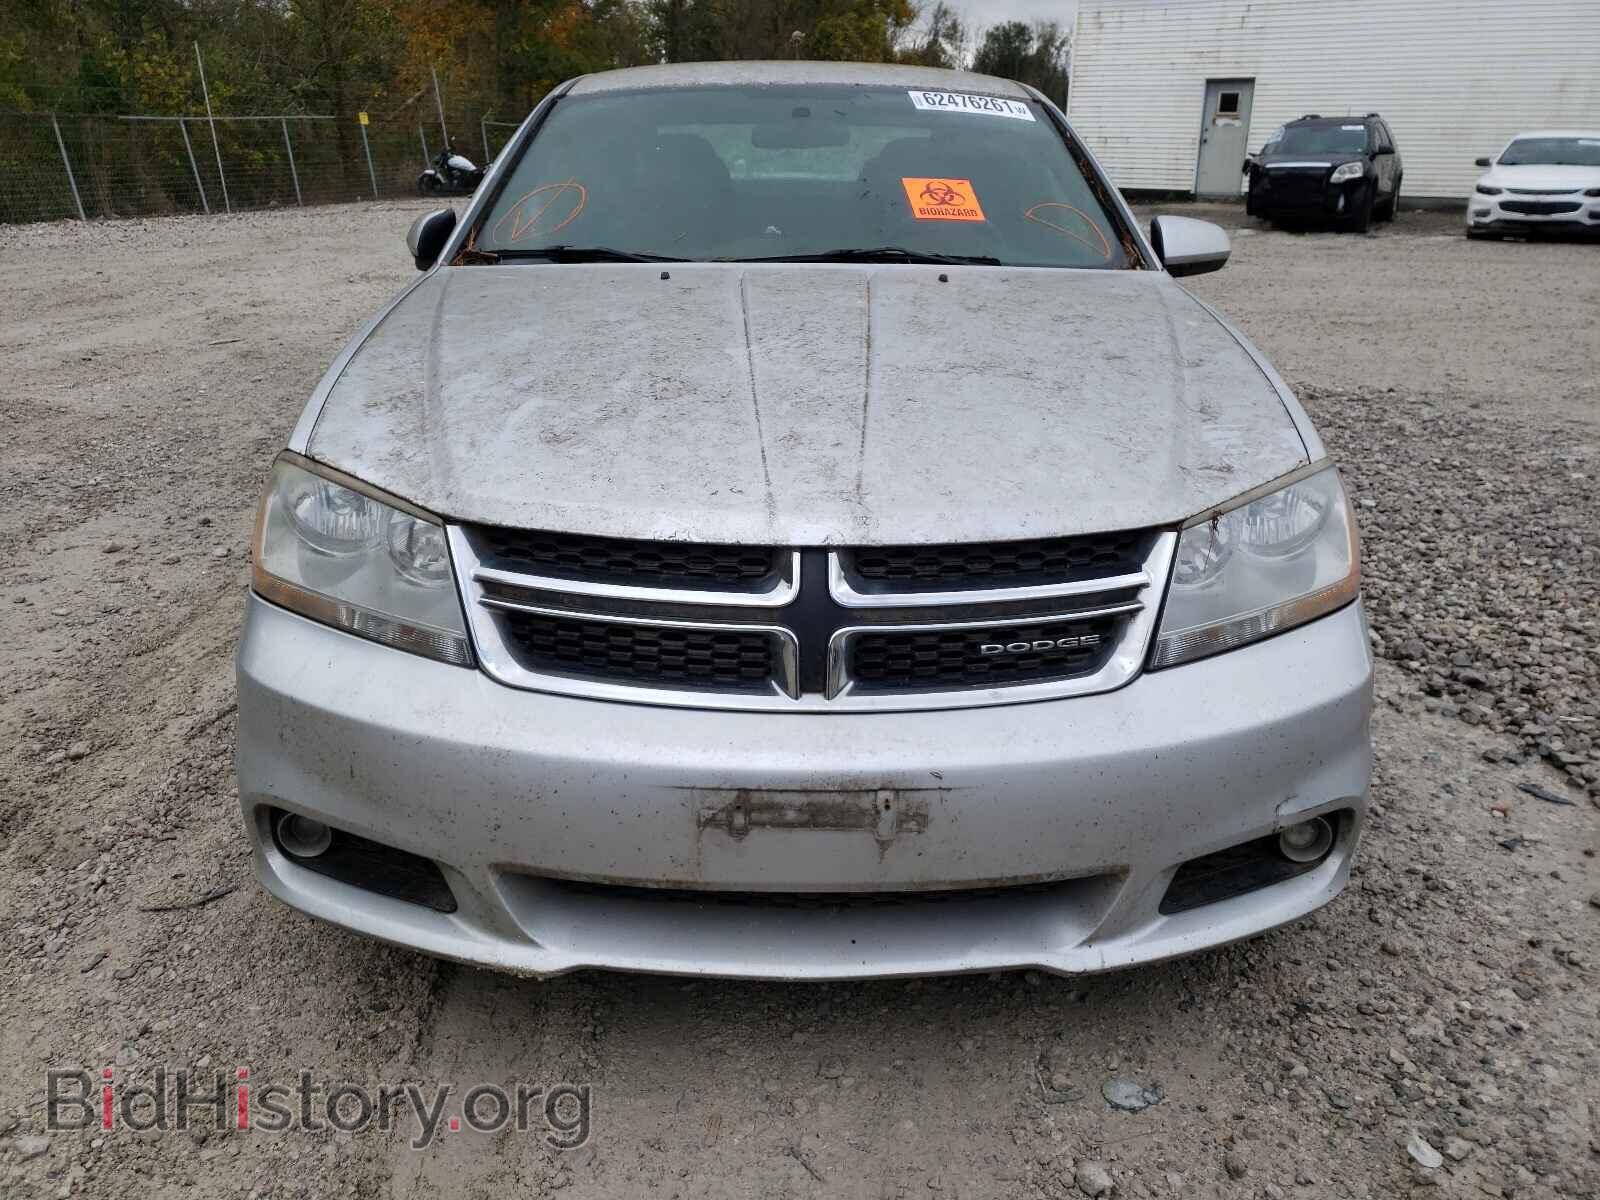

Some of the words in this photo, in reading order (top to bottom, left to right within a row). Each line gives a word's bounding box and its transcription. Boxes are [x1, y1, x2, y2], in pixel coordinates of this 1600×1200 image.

[923, 92, 1014, 114] 62476261
[919, 207, 978, 217] BIOHAZARD
[980, 634, 1100, 655] DODGE
